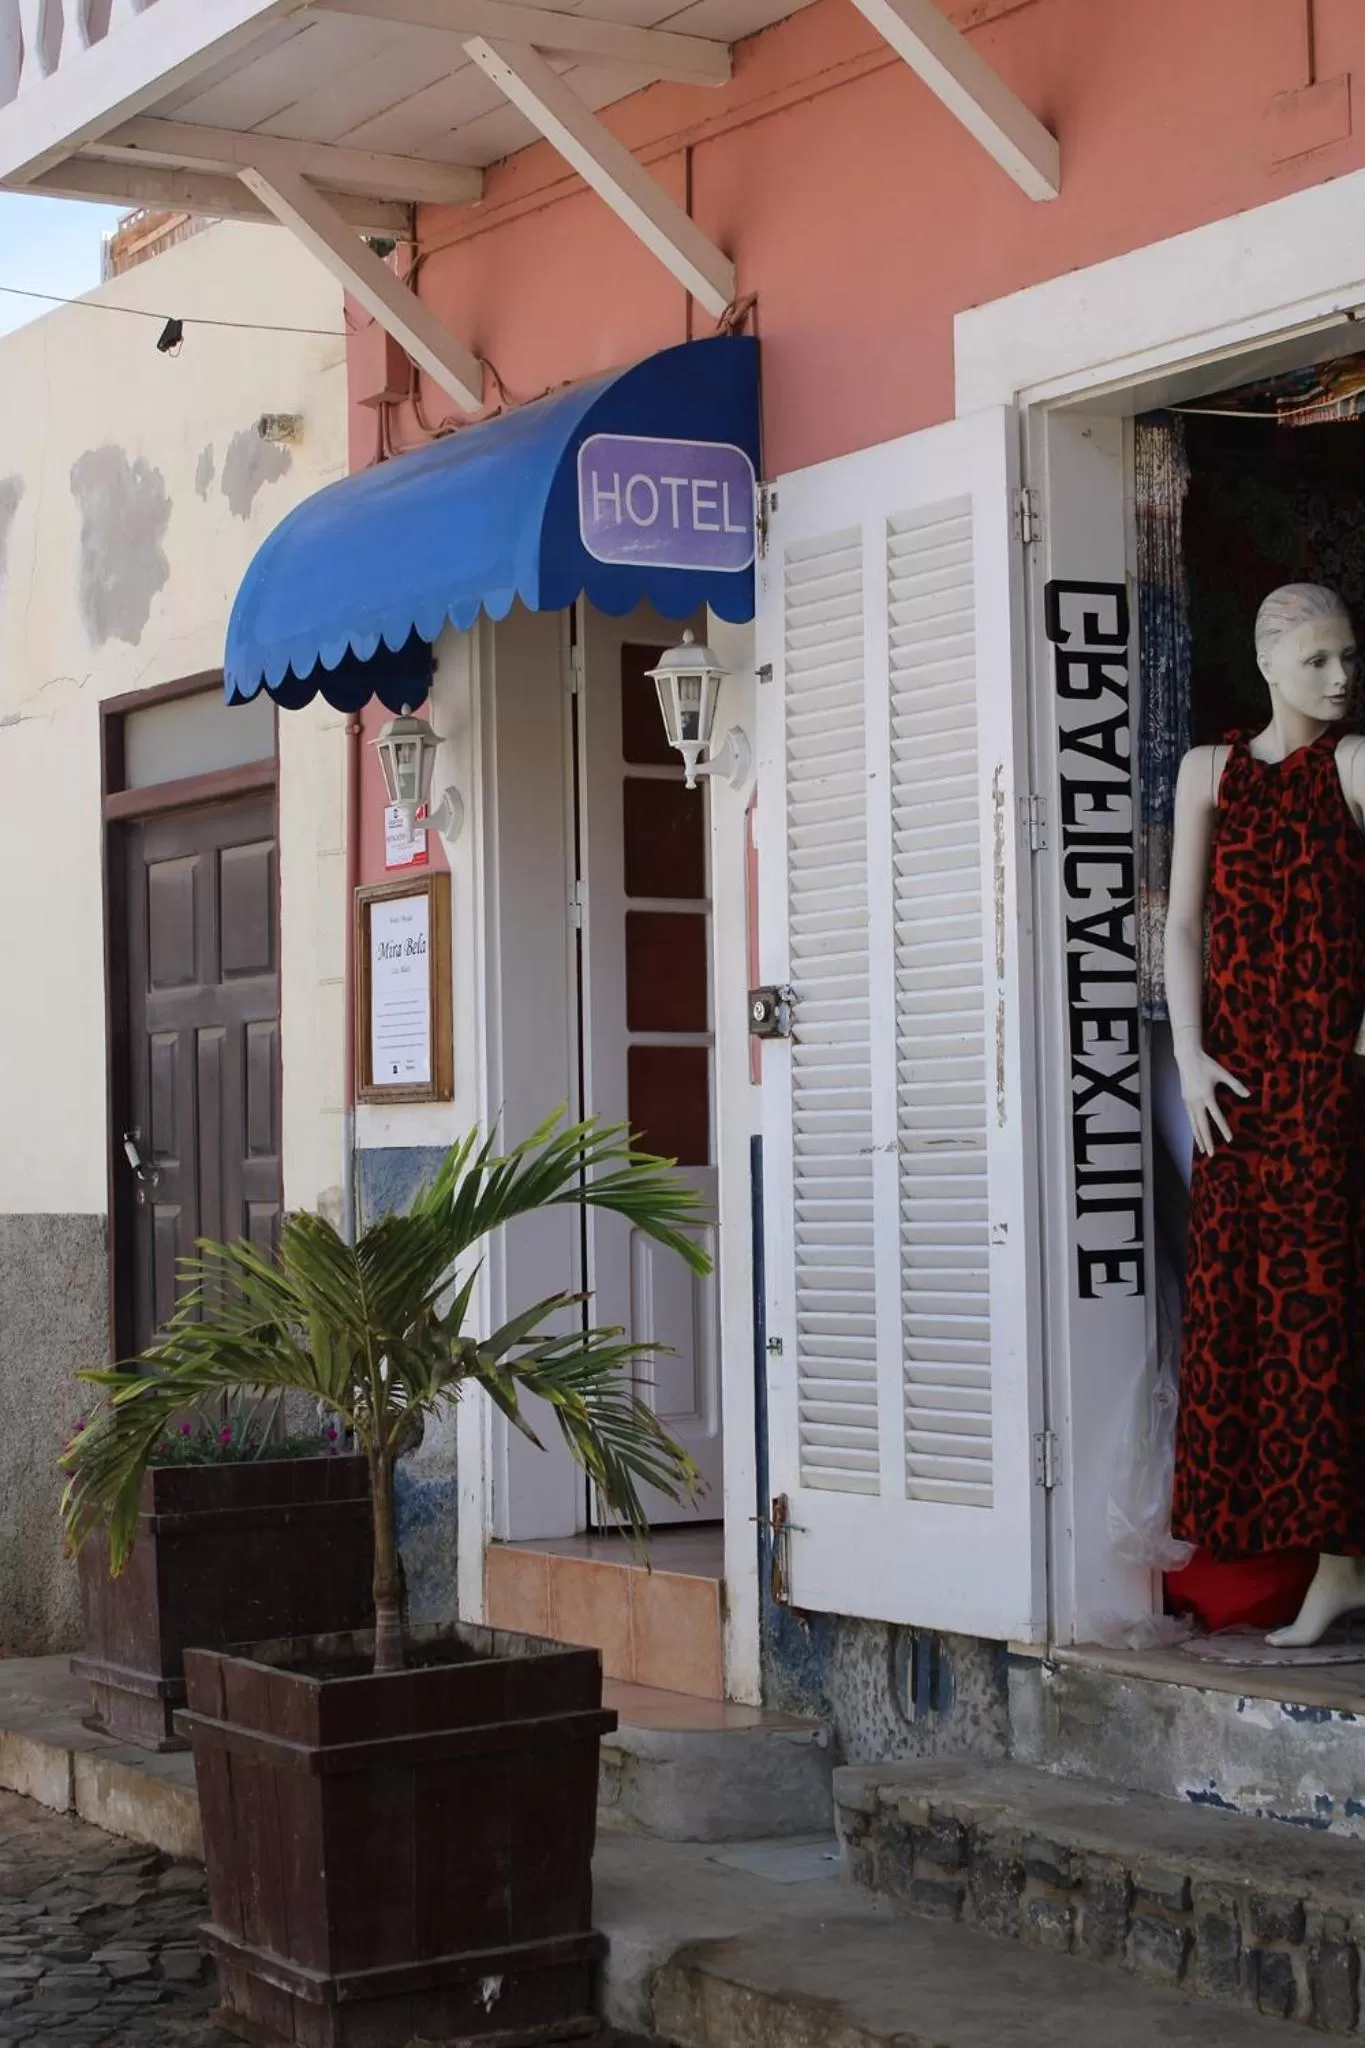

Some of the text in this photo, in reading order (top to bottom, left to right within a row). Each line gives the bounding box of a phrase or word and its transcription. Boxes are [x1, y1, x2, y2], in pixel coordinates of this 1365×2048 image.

[592, 470, 747, 533] HOTEL
[377, 932, 426, 961] Mira Bela
